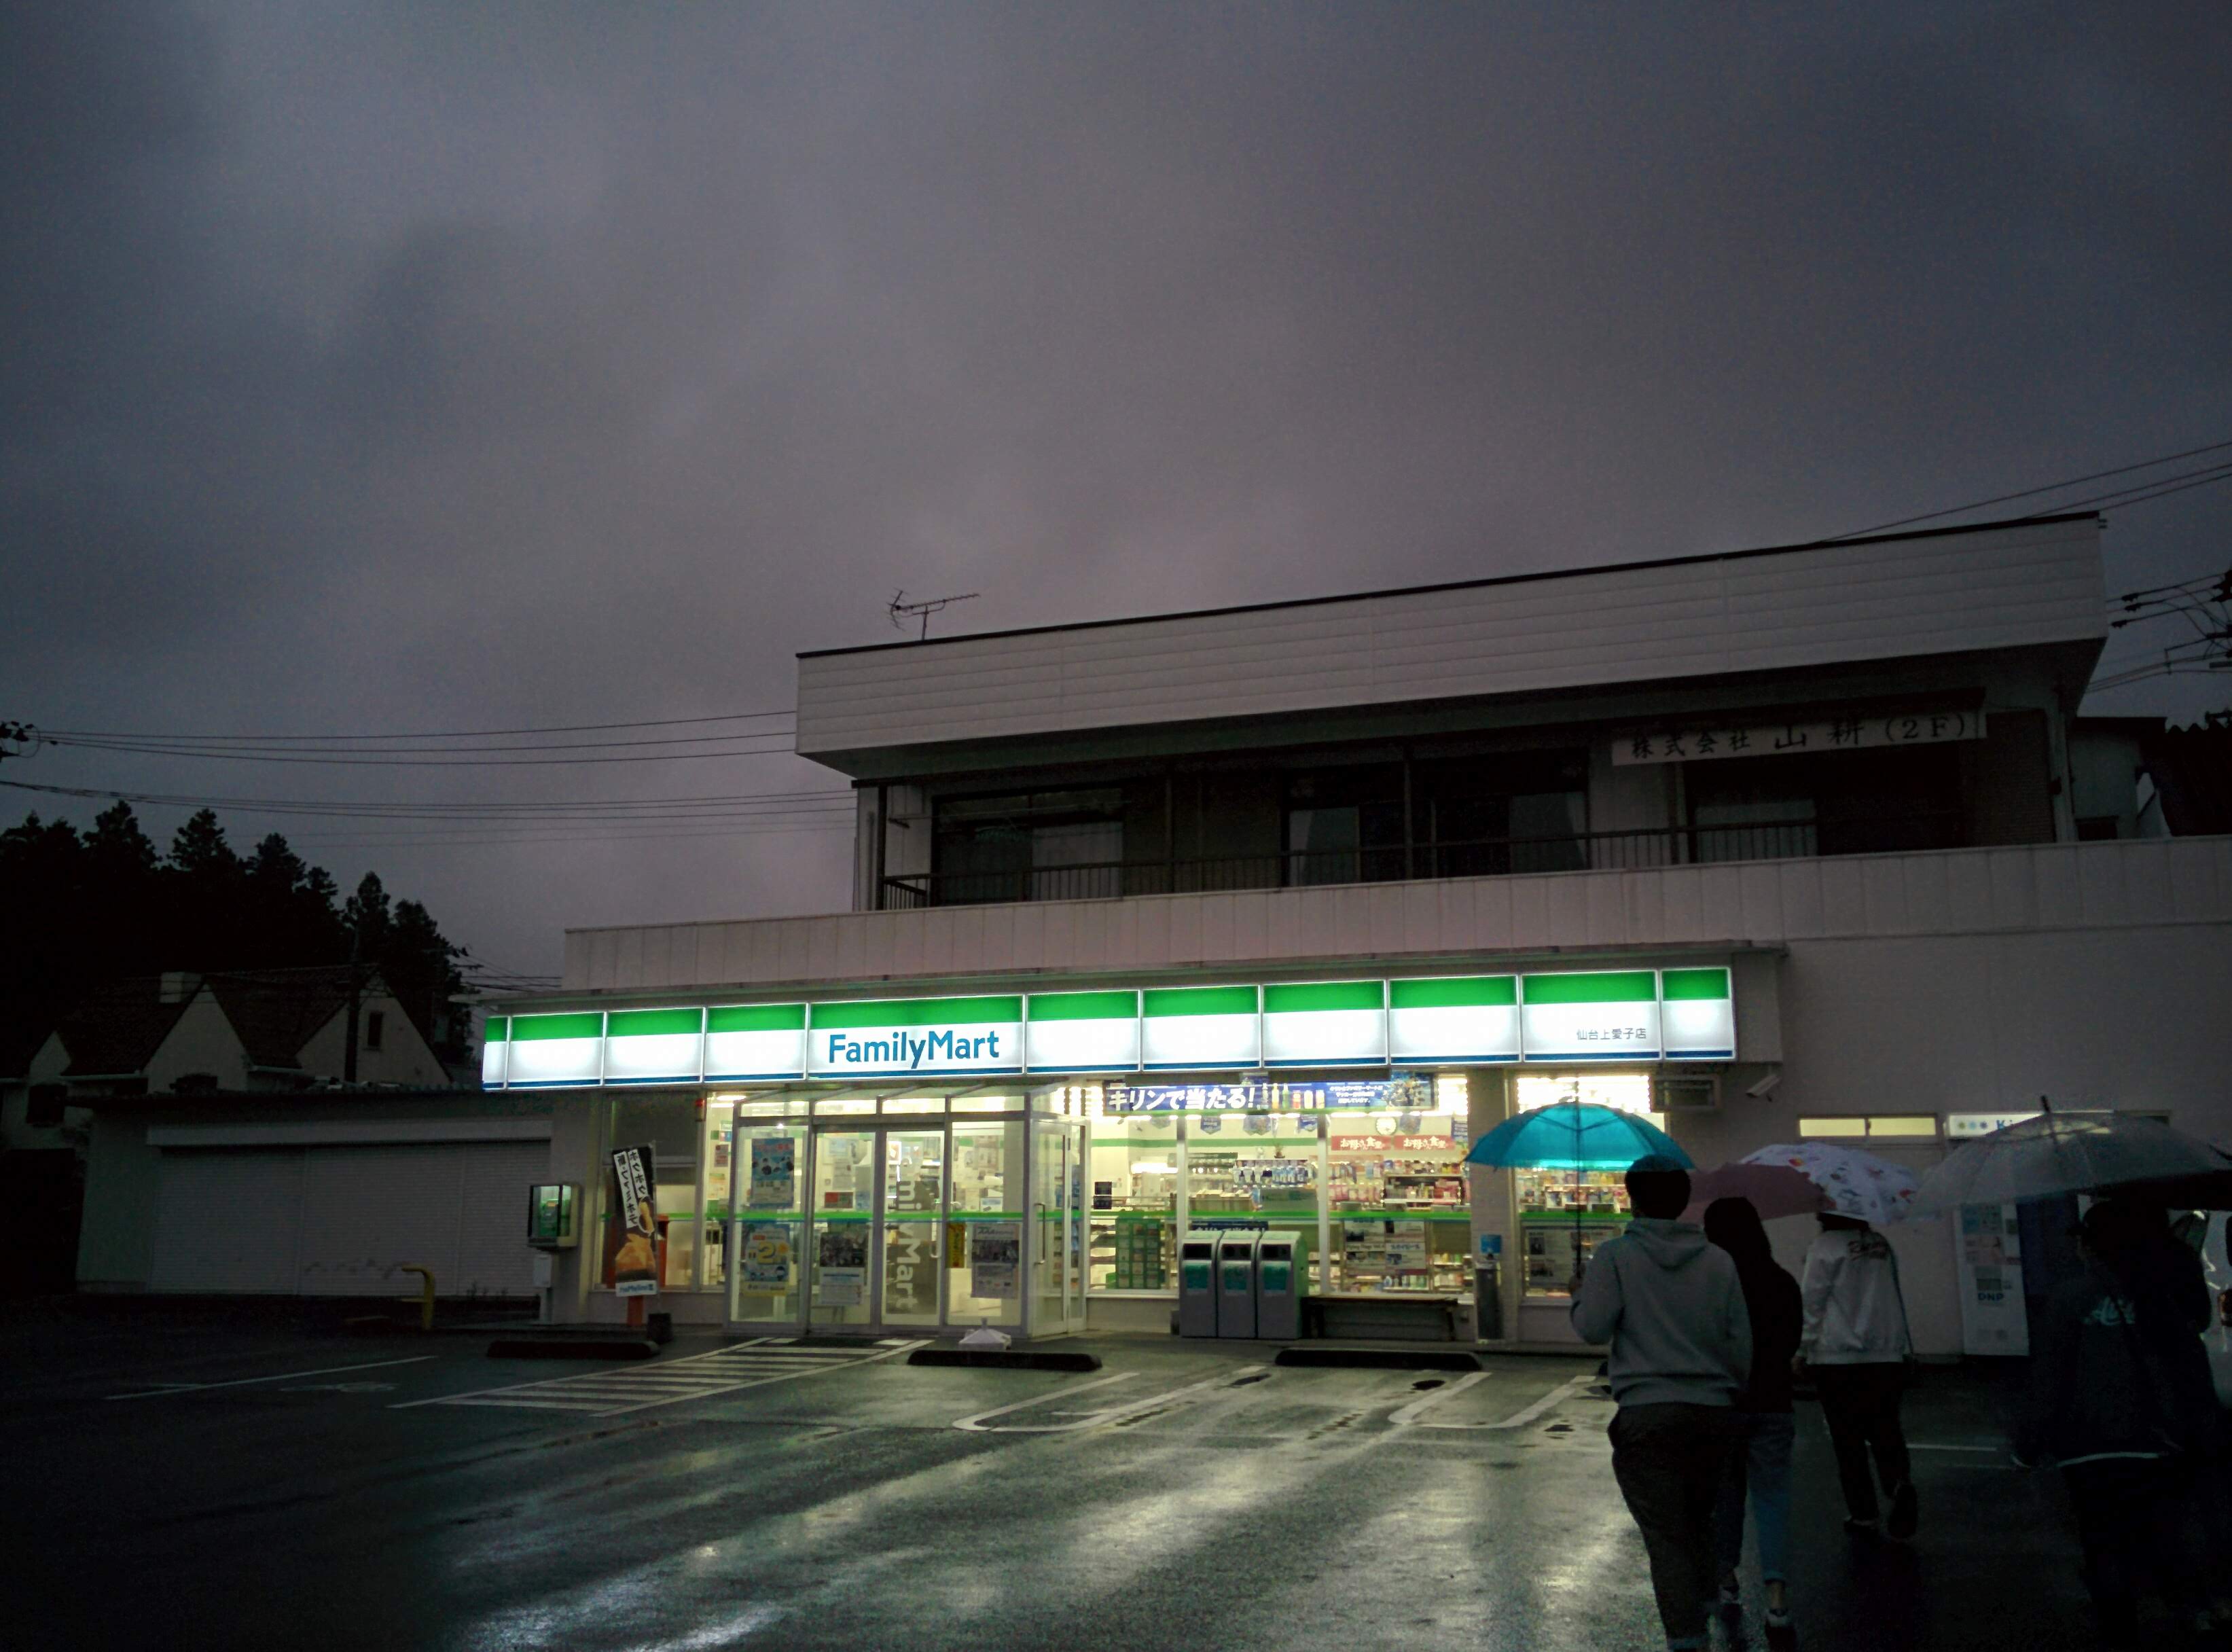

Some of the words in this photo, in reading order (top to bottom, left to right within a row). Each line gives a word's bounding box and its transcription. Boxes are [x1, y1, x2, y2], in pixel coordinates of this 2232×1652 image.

[1577, 1028, 1647, 1041] 仙台上愛子店
[829, 1030, 1000, 1070] FamilyMart
[1977, 1293, 2004, 1301] DNP
